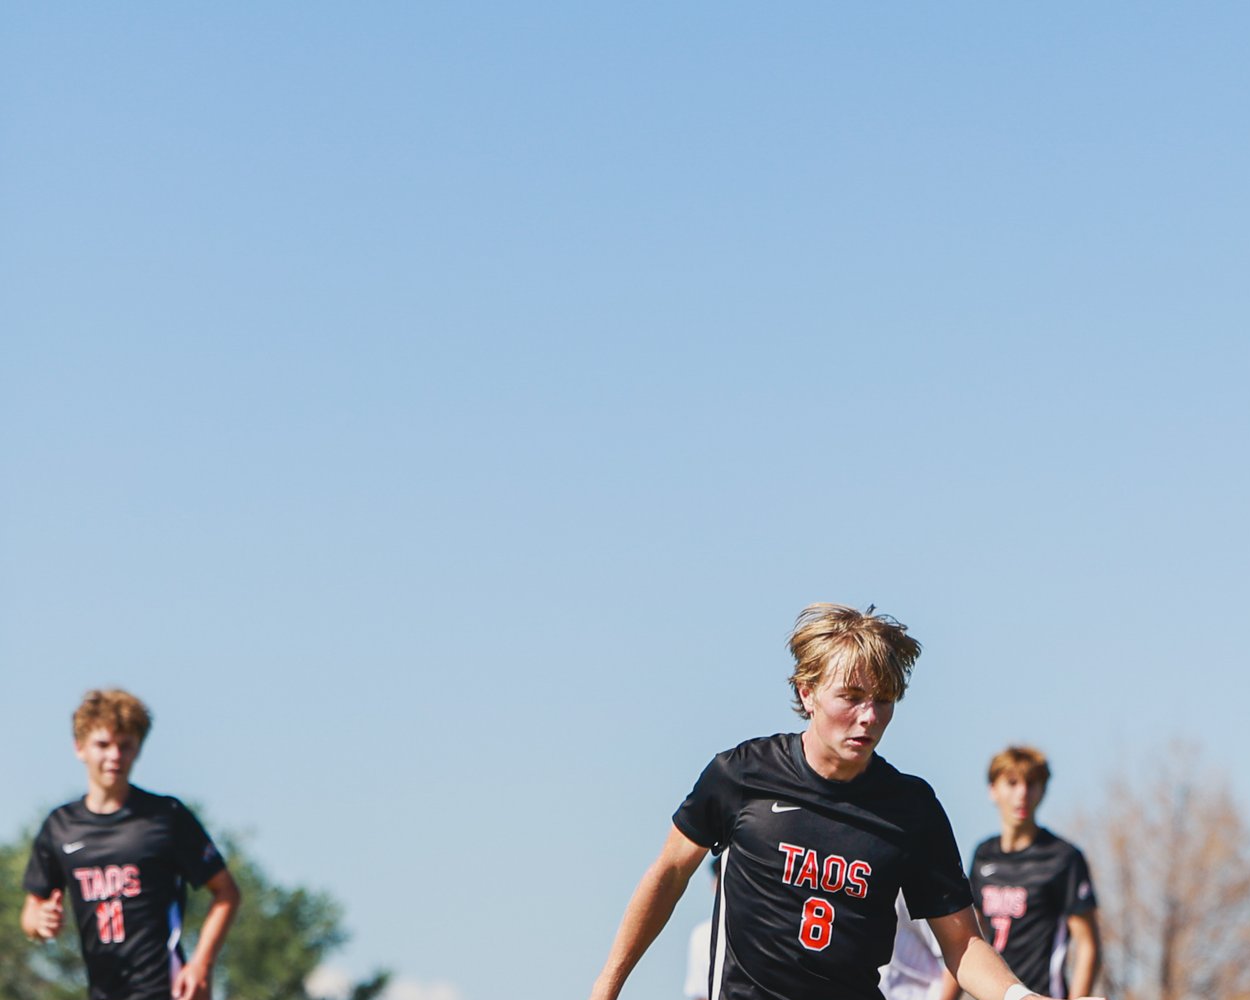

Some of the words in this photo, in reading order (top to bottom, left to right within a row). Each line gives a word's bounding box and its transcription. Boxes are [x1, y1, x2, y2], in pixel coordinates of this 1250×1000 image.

[73, 864, 141, 901] TAOS
[778, 842, 872, 899] TAOS
[798, 896, 835, 952] 8
